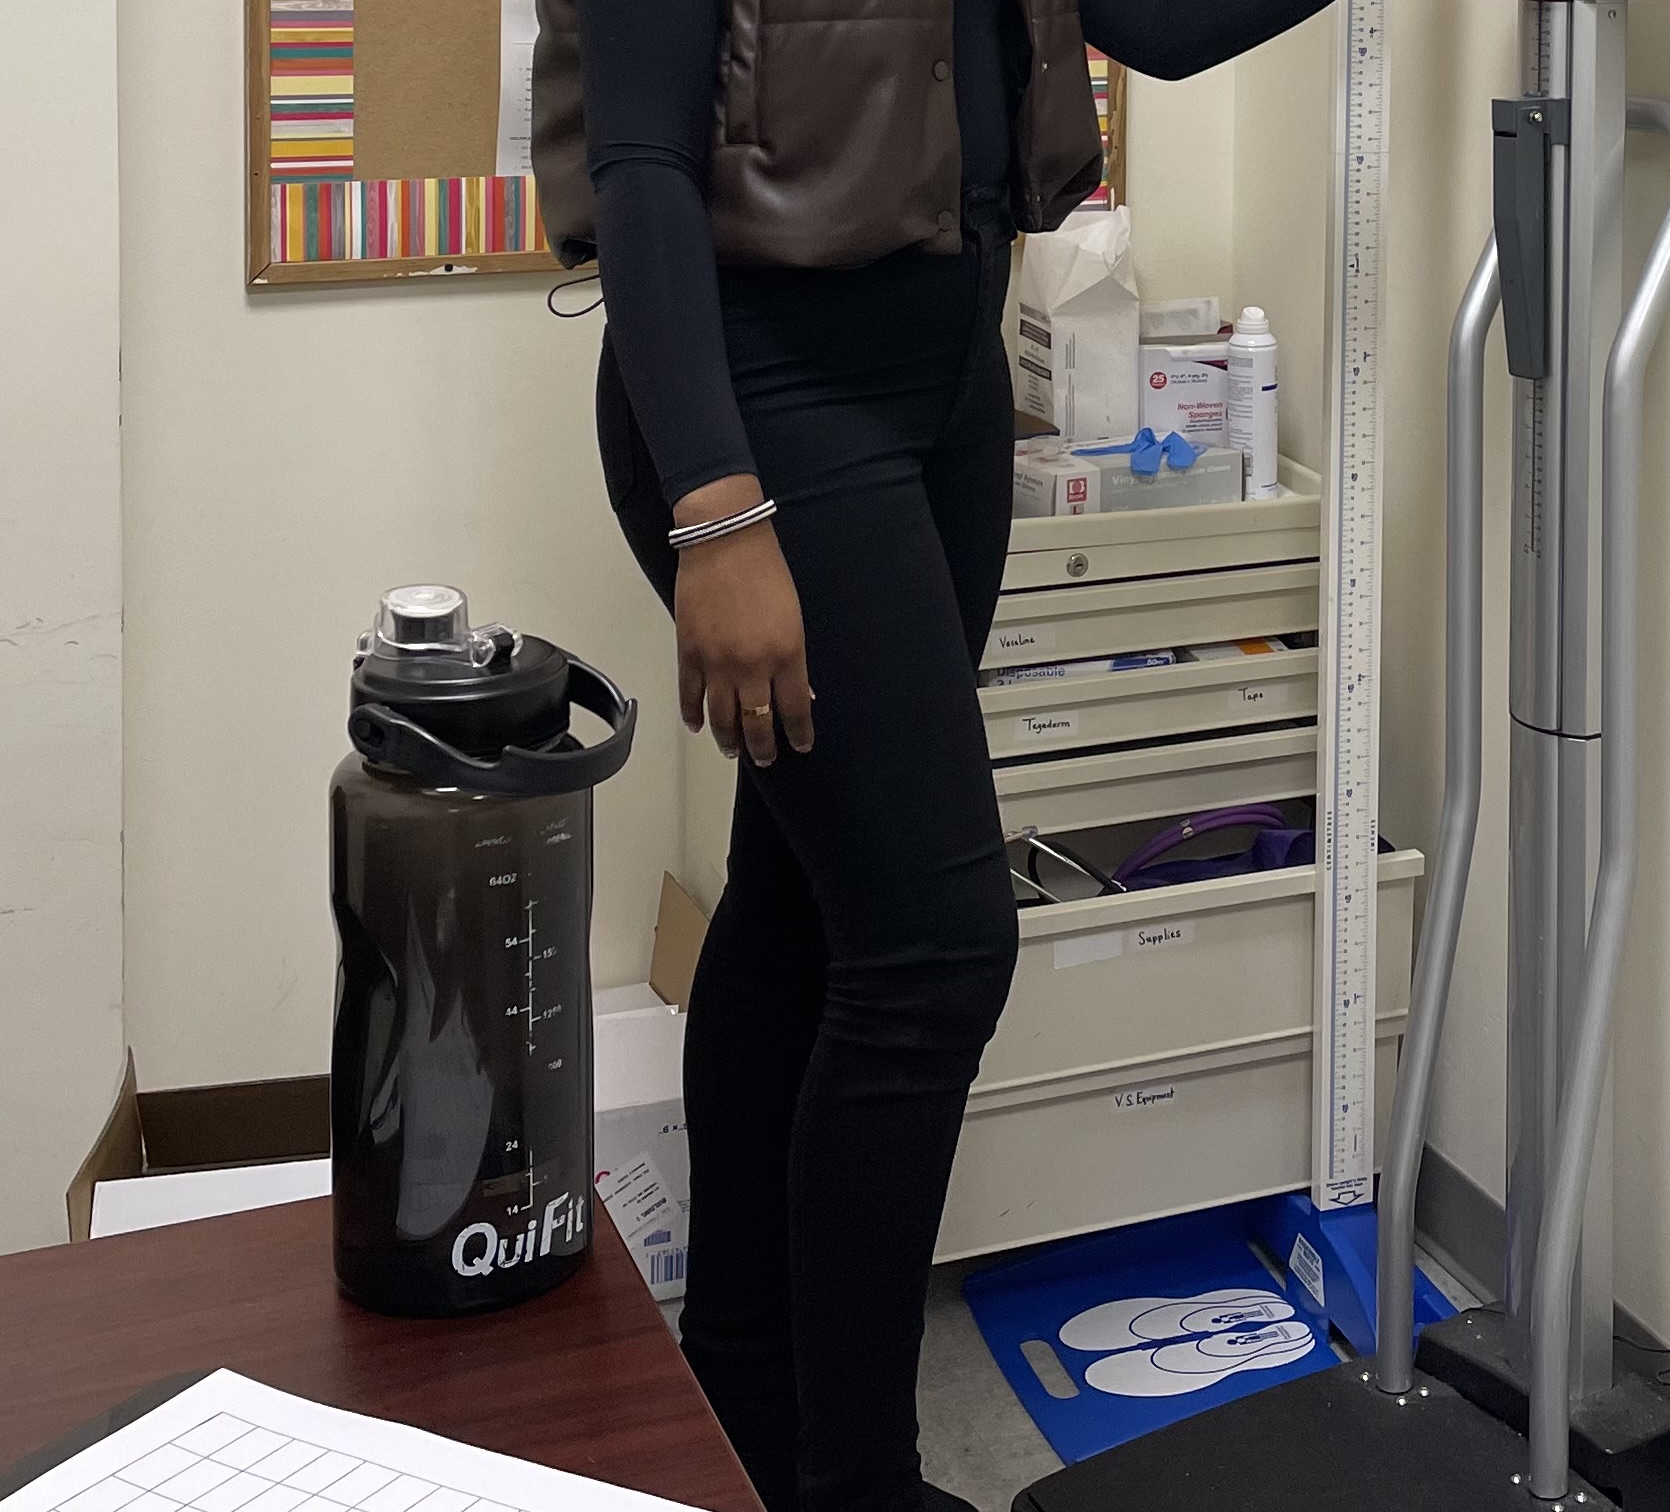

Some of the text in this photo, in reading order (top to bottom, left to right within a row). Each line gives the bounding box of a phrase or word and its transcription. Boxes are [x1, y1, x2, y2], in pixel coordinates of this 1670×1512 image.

[1188, 411, 1222, 419] Sponges
[997, 667, 1065, 680] Disposable
[1238, 687, 1263, 701] Tape
[1138, 927, 1181, 945] Supplies
[505, 937, 518, 948] 54
[505, 1140, 518, 1151] 24
[506, 1205, 518, 1216] 14
[452, 1192, 585, 1277] QuiFit
